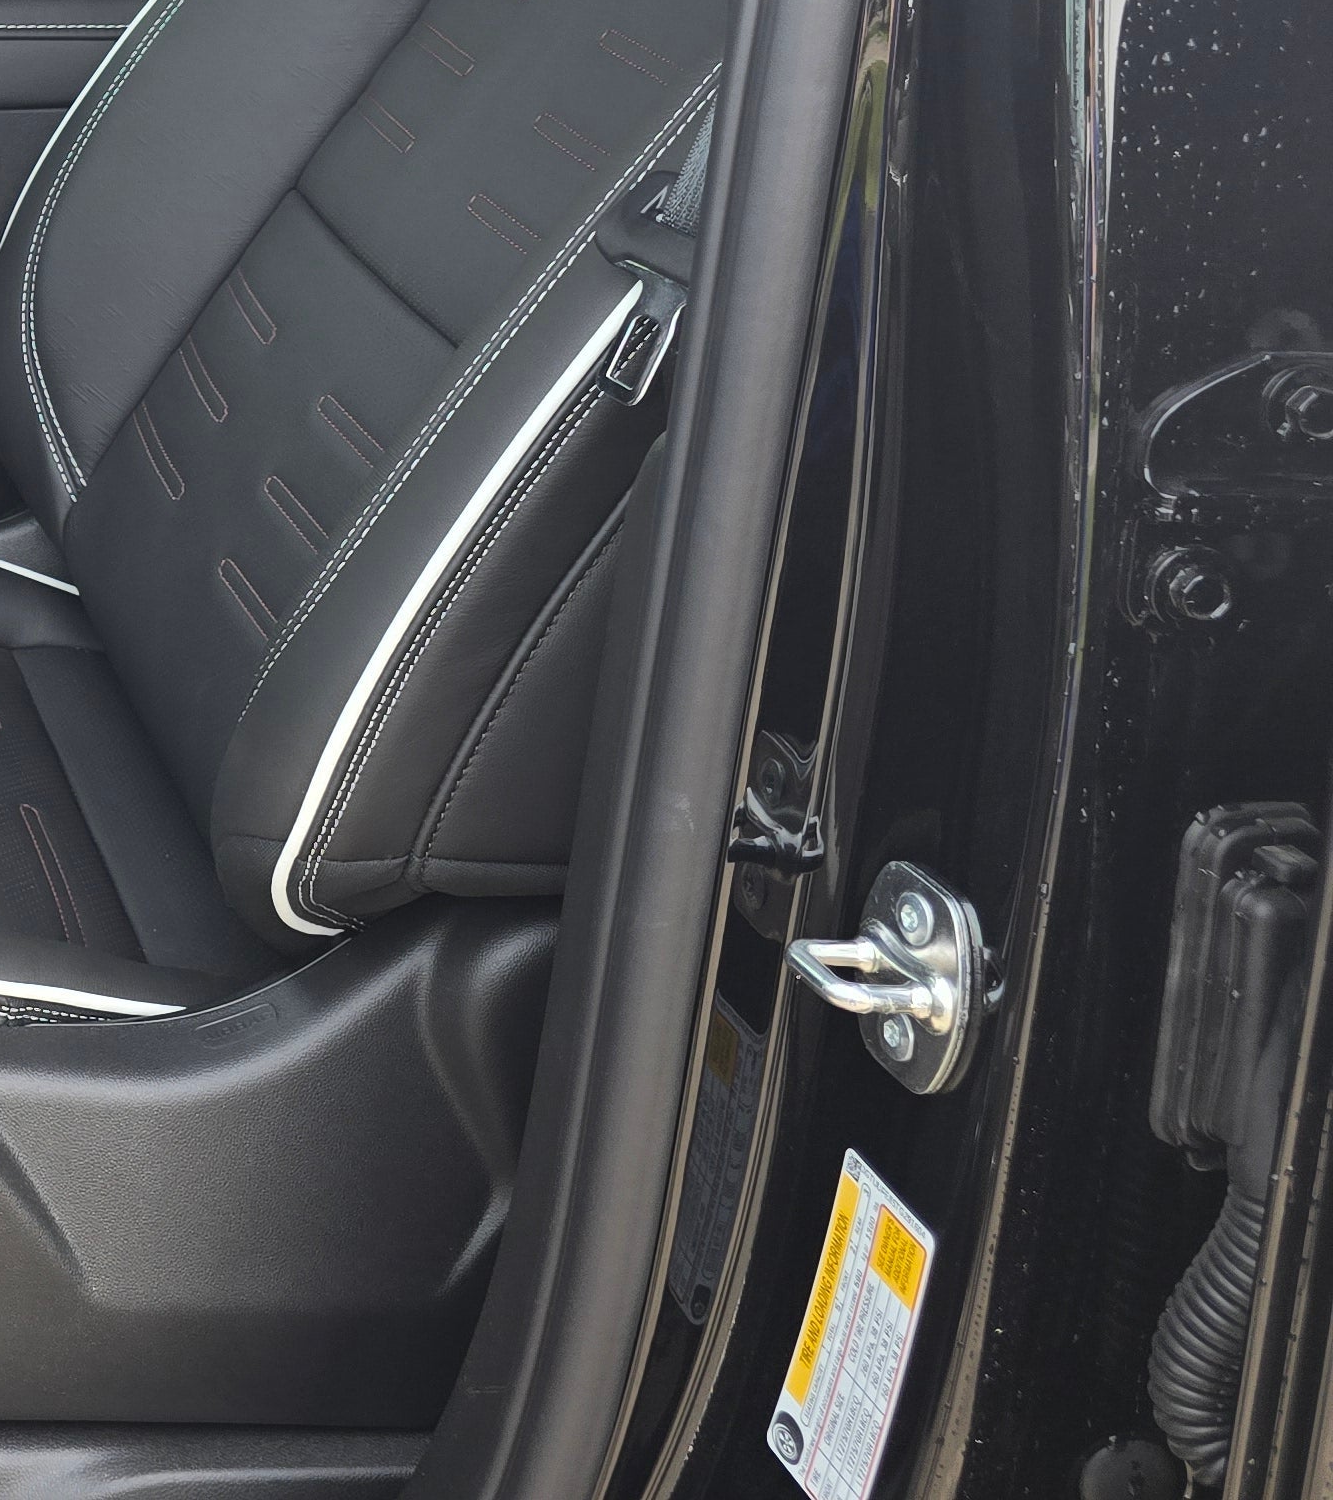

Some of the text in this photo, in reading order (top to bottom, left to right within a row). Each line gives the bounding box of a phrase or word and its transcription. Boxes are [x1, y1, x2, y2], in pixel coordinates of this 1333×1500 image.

[824, 1210, 849, 1280] INFORMATION
[812, 1276, 832, 1325] LOADING
[806, 1320, 820, 1347] AND
[799, 1340, 815, 1369] TIRE
